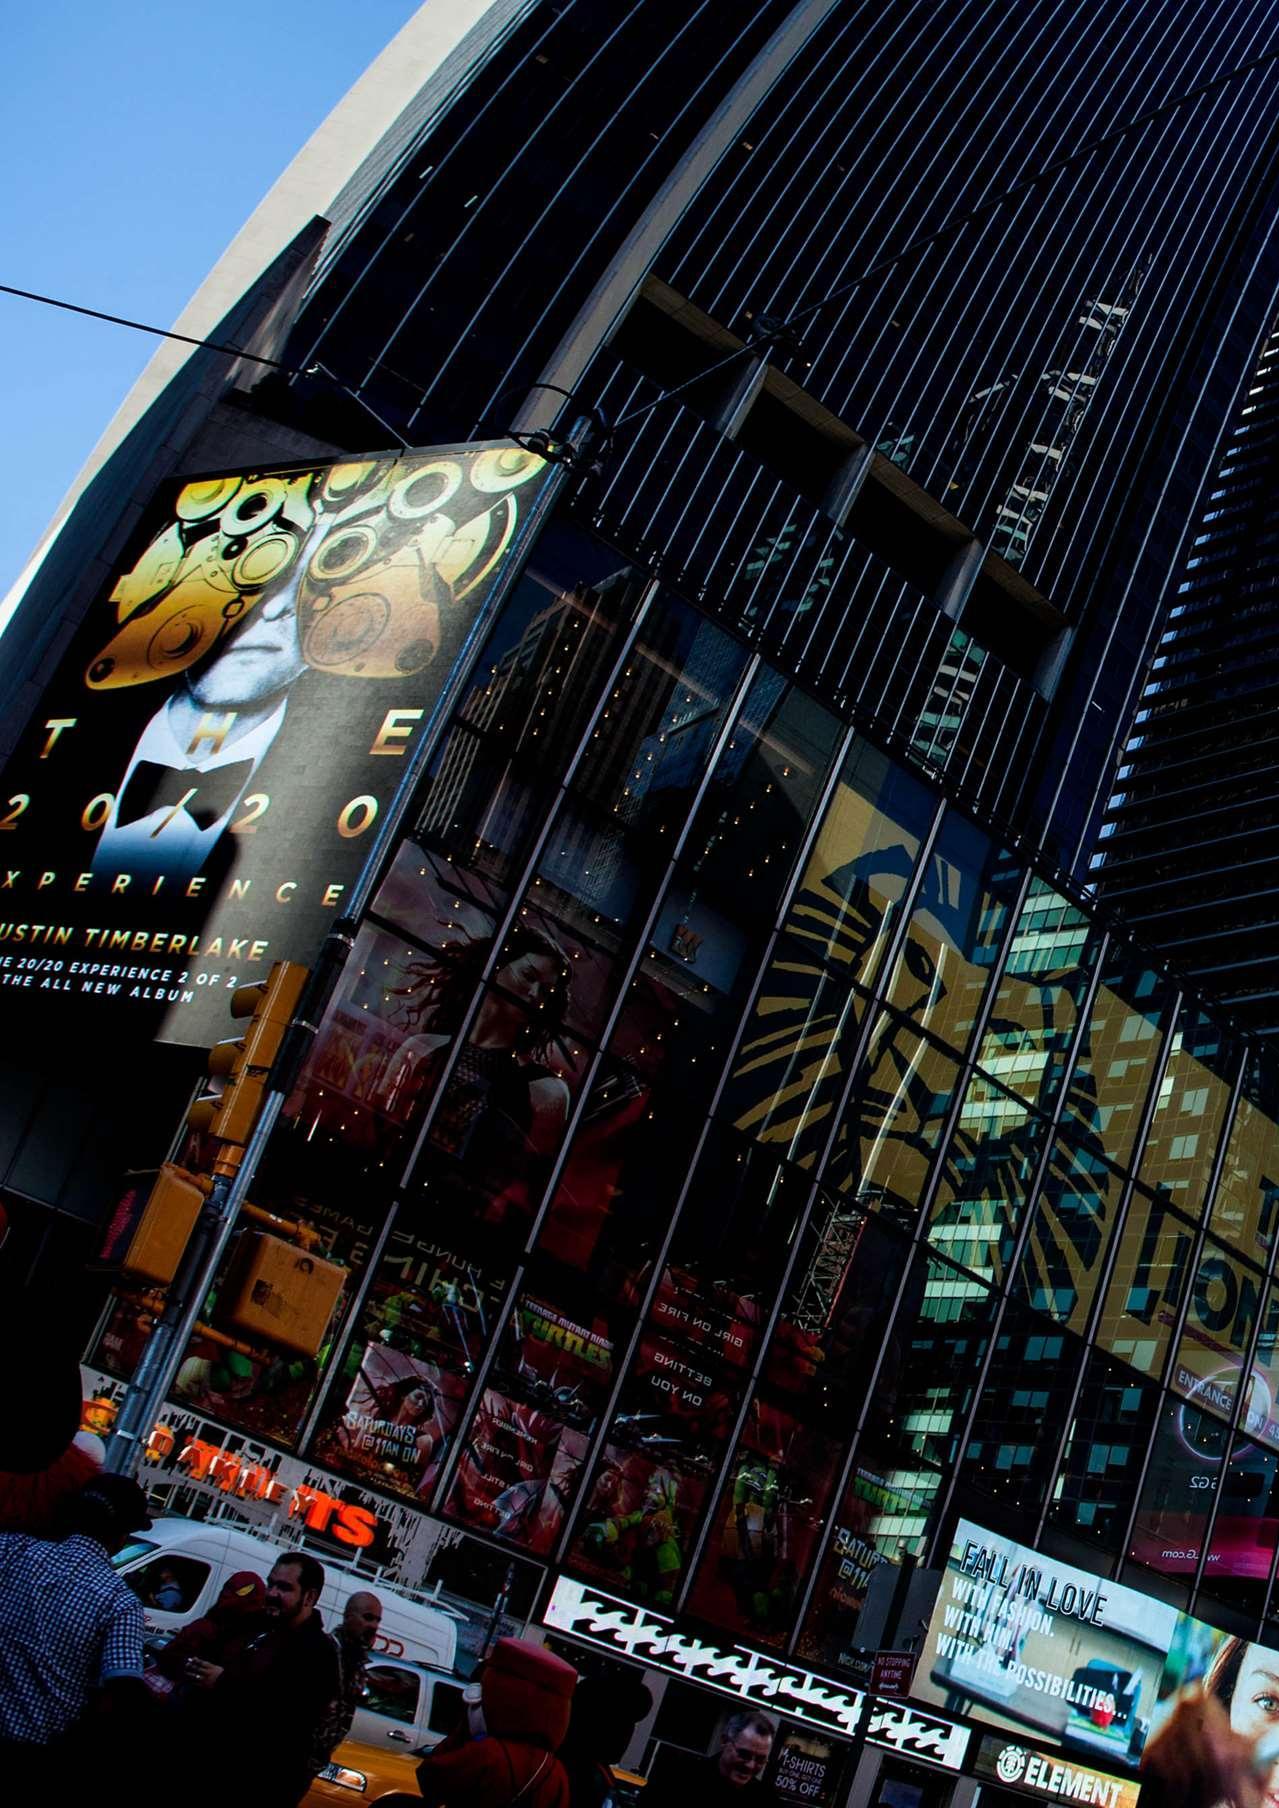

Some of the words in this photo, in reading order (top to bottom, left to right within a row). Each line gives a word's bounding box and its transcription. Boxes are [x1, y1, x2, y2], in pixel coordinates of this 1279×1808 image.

[0, 787, 380, 840] 20/20
[84, 927, 269, 962] TIMBERLAKE
[2, 972, 33, 988] THE
[40, 975, 73, 992] ALL
[80, 980, 121, 997] NEW
[130, 985, 195, 1004] ALBUM
[16, 957, 64, 973] 20/20
[68, 961, 173, 984] EXPERIENCE
[176, 970, 189, 985] 2
[196, 971, 221, 987] OF
[226, 974, 240, 989] 2
[1177, 1368, 1234, 1411] ENTRANCE
[343, 1411, 417, 1445] SATURDAYS
[362, 1433, 401, 1457] @11AM
[402, 1446, 422, 1464] ON
[959, 1541, 1010, 1589] FALL
[1017, 1564, 1043, 1600] IN
[1046, 1575, 1108, 1627] LOVE
[944, 1605, 983, 1641] WITH
[951, 1577, 991, 1611] WITH
[990, 1591, 1055, 1638] FASHION.
[935, 1632, 976, 1667] WITH
[775, 1774, 798, 1792] 50%
[799, 1782, 821, 1798] OFF
[1023, 1755, 1125, 1808] ELEMENT
